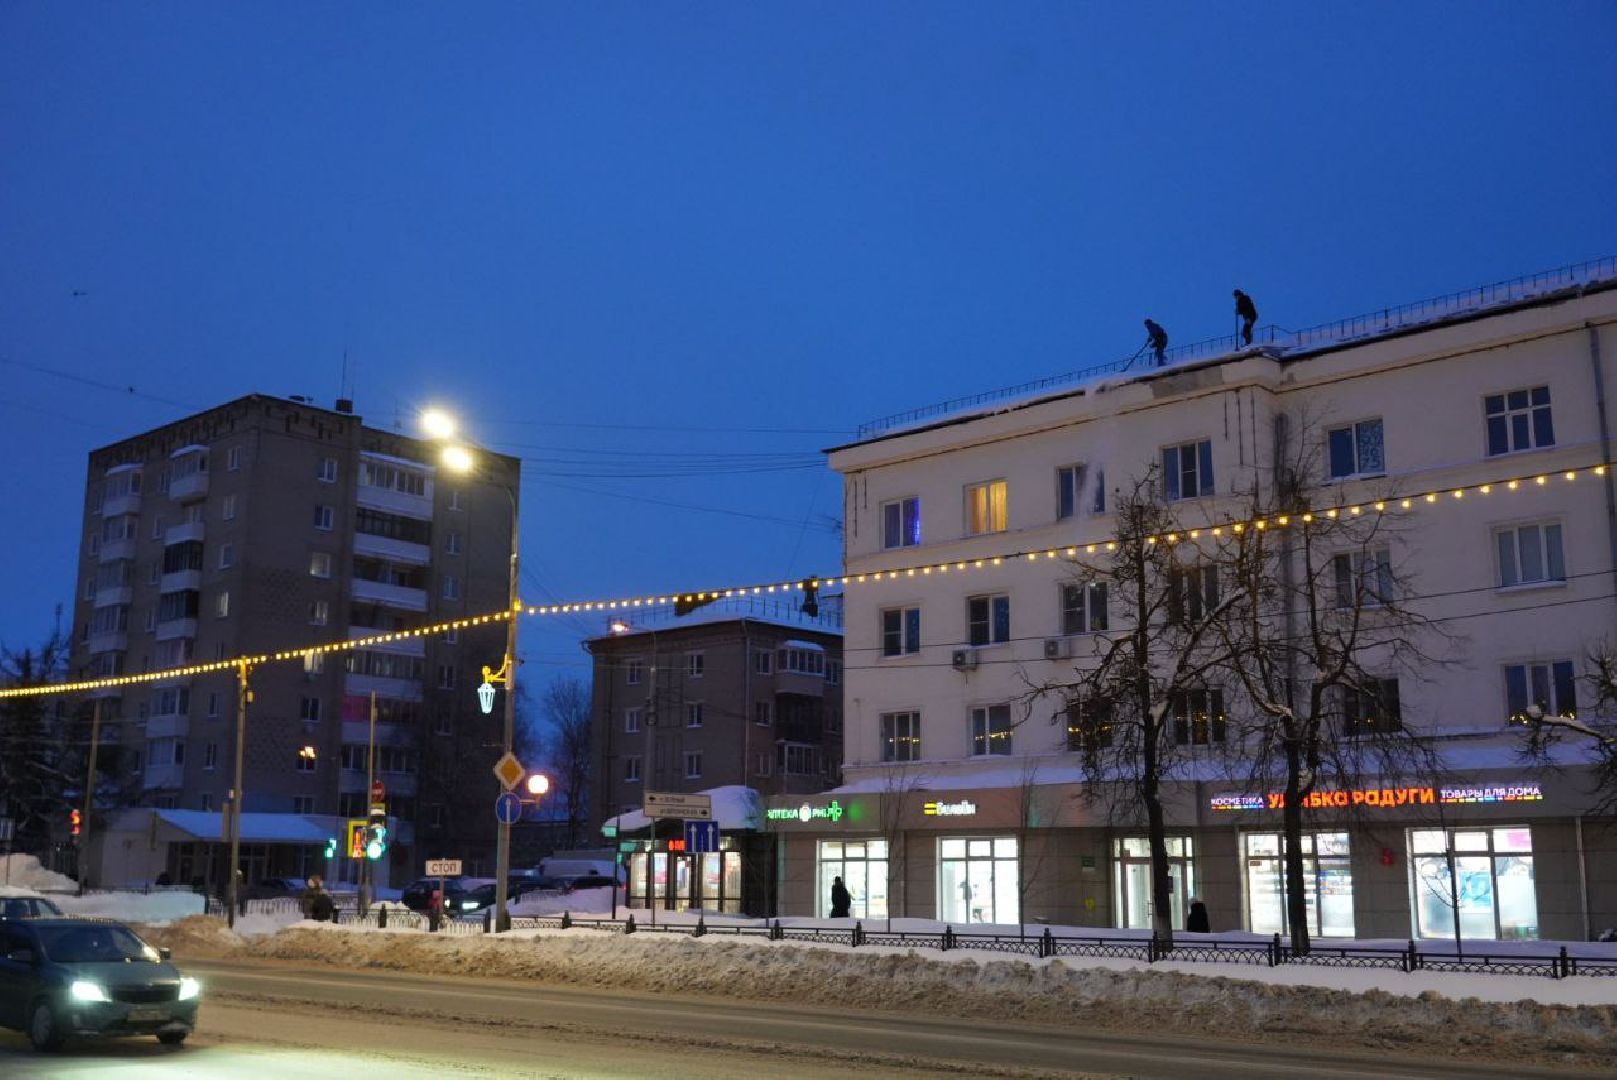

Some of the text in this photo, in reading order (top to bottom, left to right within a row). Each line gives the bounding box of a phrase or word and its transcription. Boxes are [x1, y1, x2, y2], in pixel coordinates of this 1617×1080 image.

[1267, 788, 1434, 808] УБКА РАДУГИ
[1440, 786, 1541, 800] ТОВАРЫ ДЛЯ ДОМА
[1211, 796, 1264, 806] КОСМЕТИКА
[431, 863, 457, 873] СТОП
